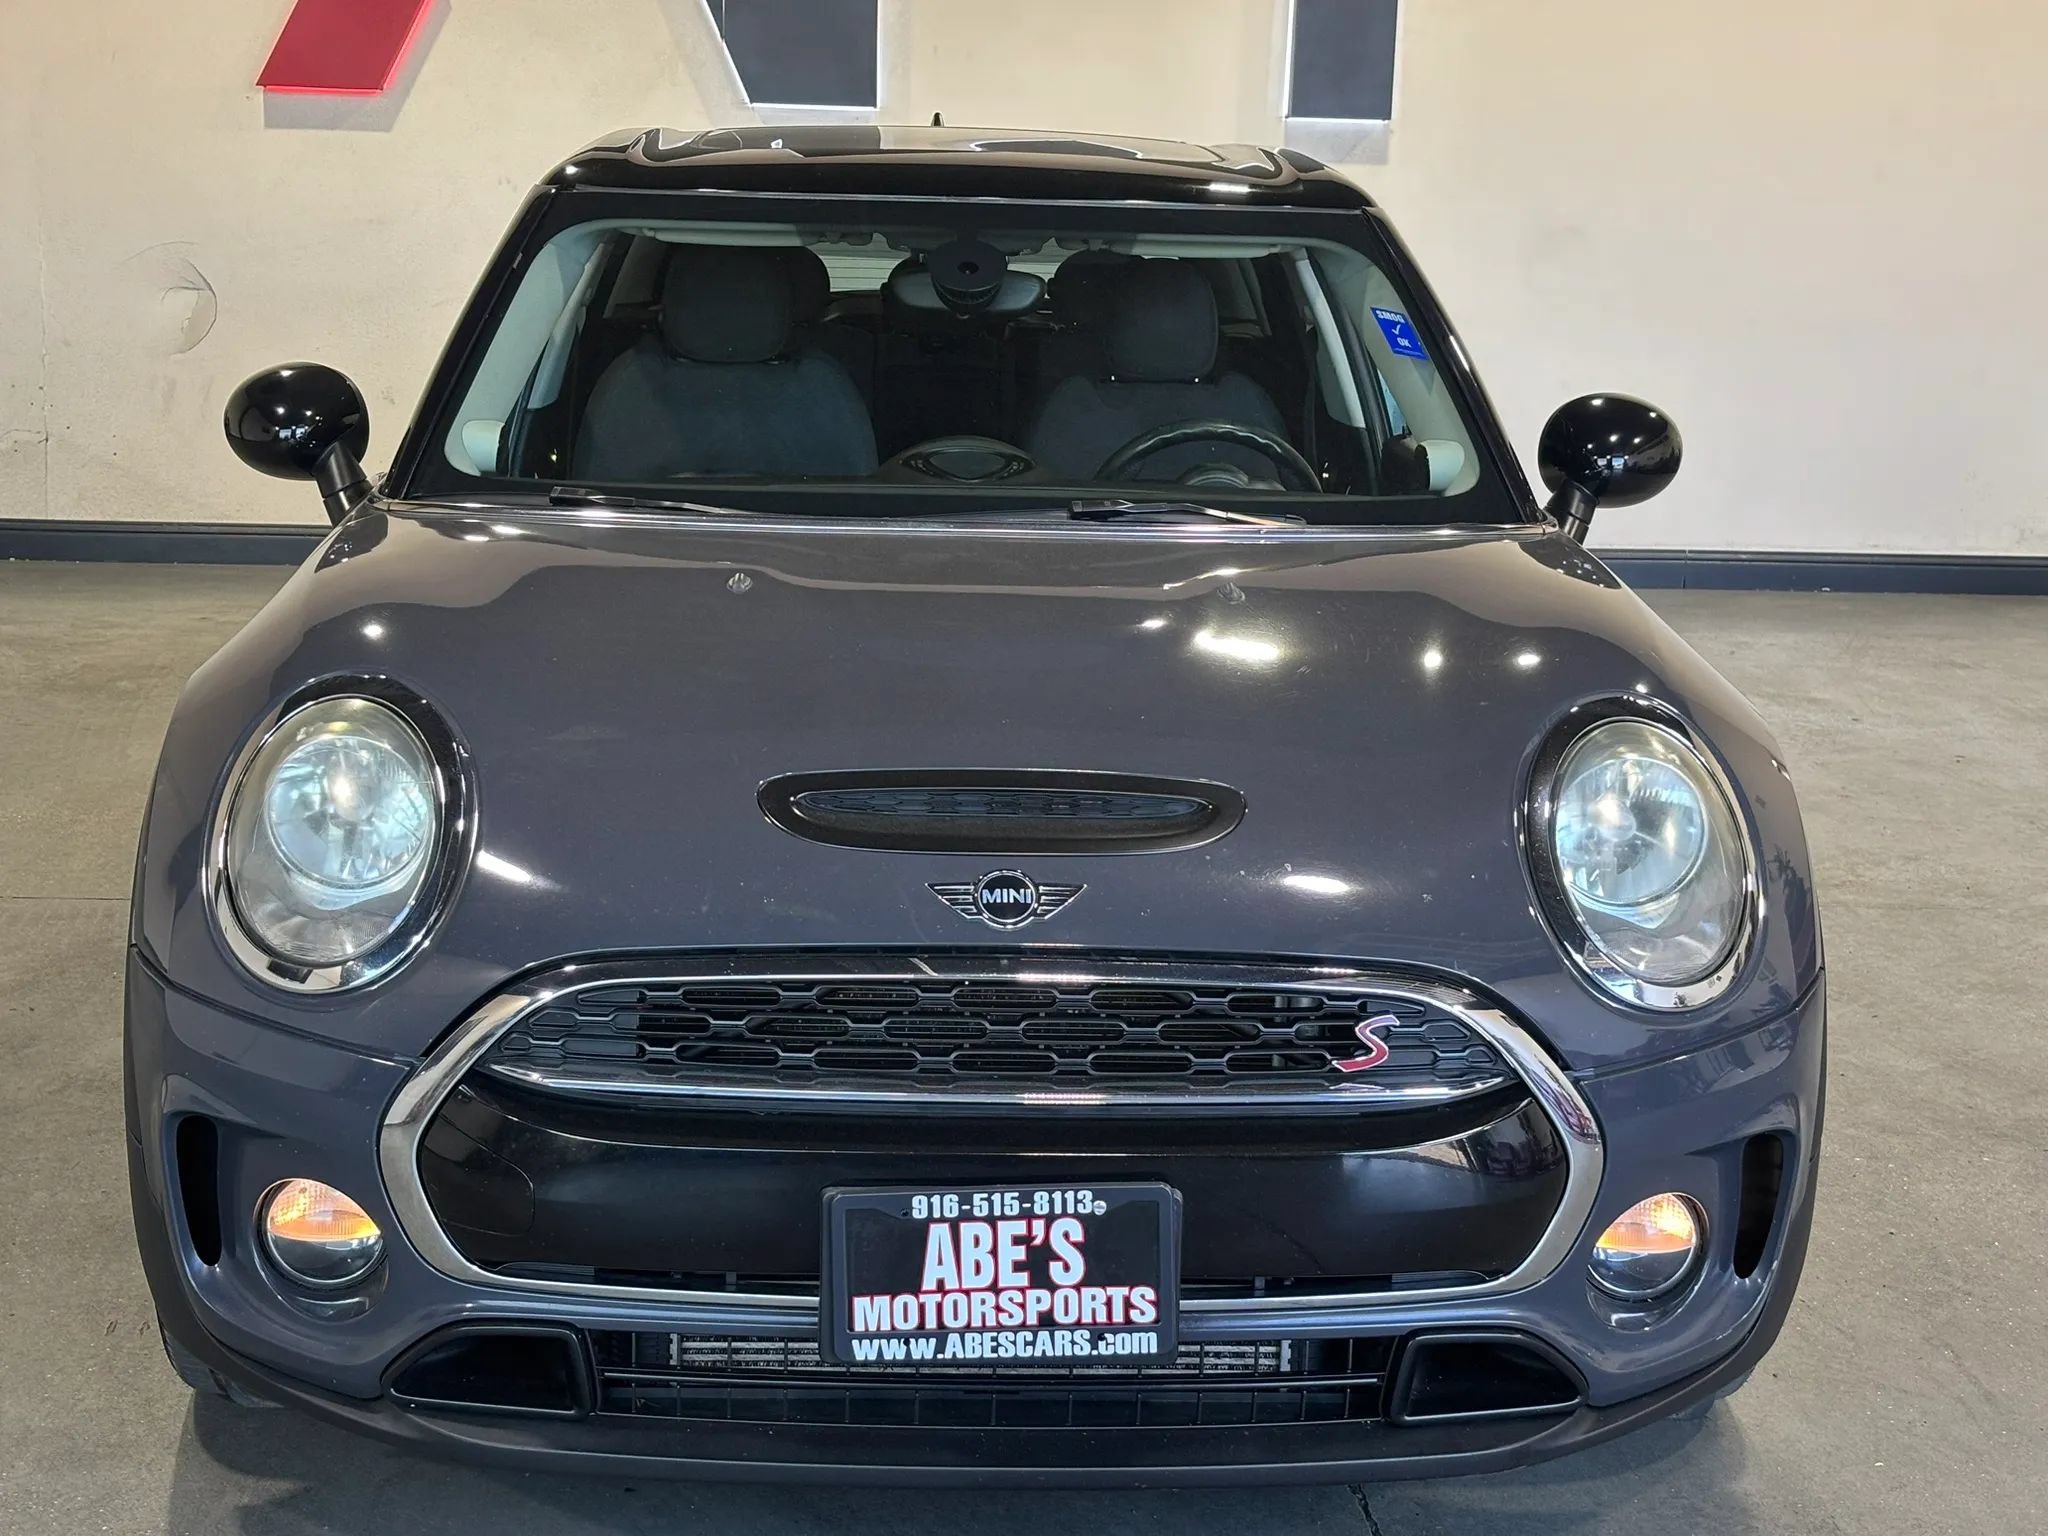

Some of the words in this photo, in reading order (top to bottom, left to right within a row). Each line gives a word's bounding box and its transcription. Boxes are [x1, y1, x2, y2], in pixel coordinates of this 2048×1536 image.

[1397, 337, 1412, 347] OK
[981, 888, 1032, 904] MINI
[1332, 1014, 1400, 1073] S
[911, 1190, 1093, 1219] 916-515-8113
[920, 1217, 1085, 1291] ABE'S
[853, 1286, 1157, 1332] MOTORSPORTS
